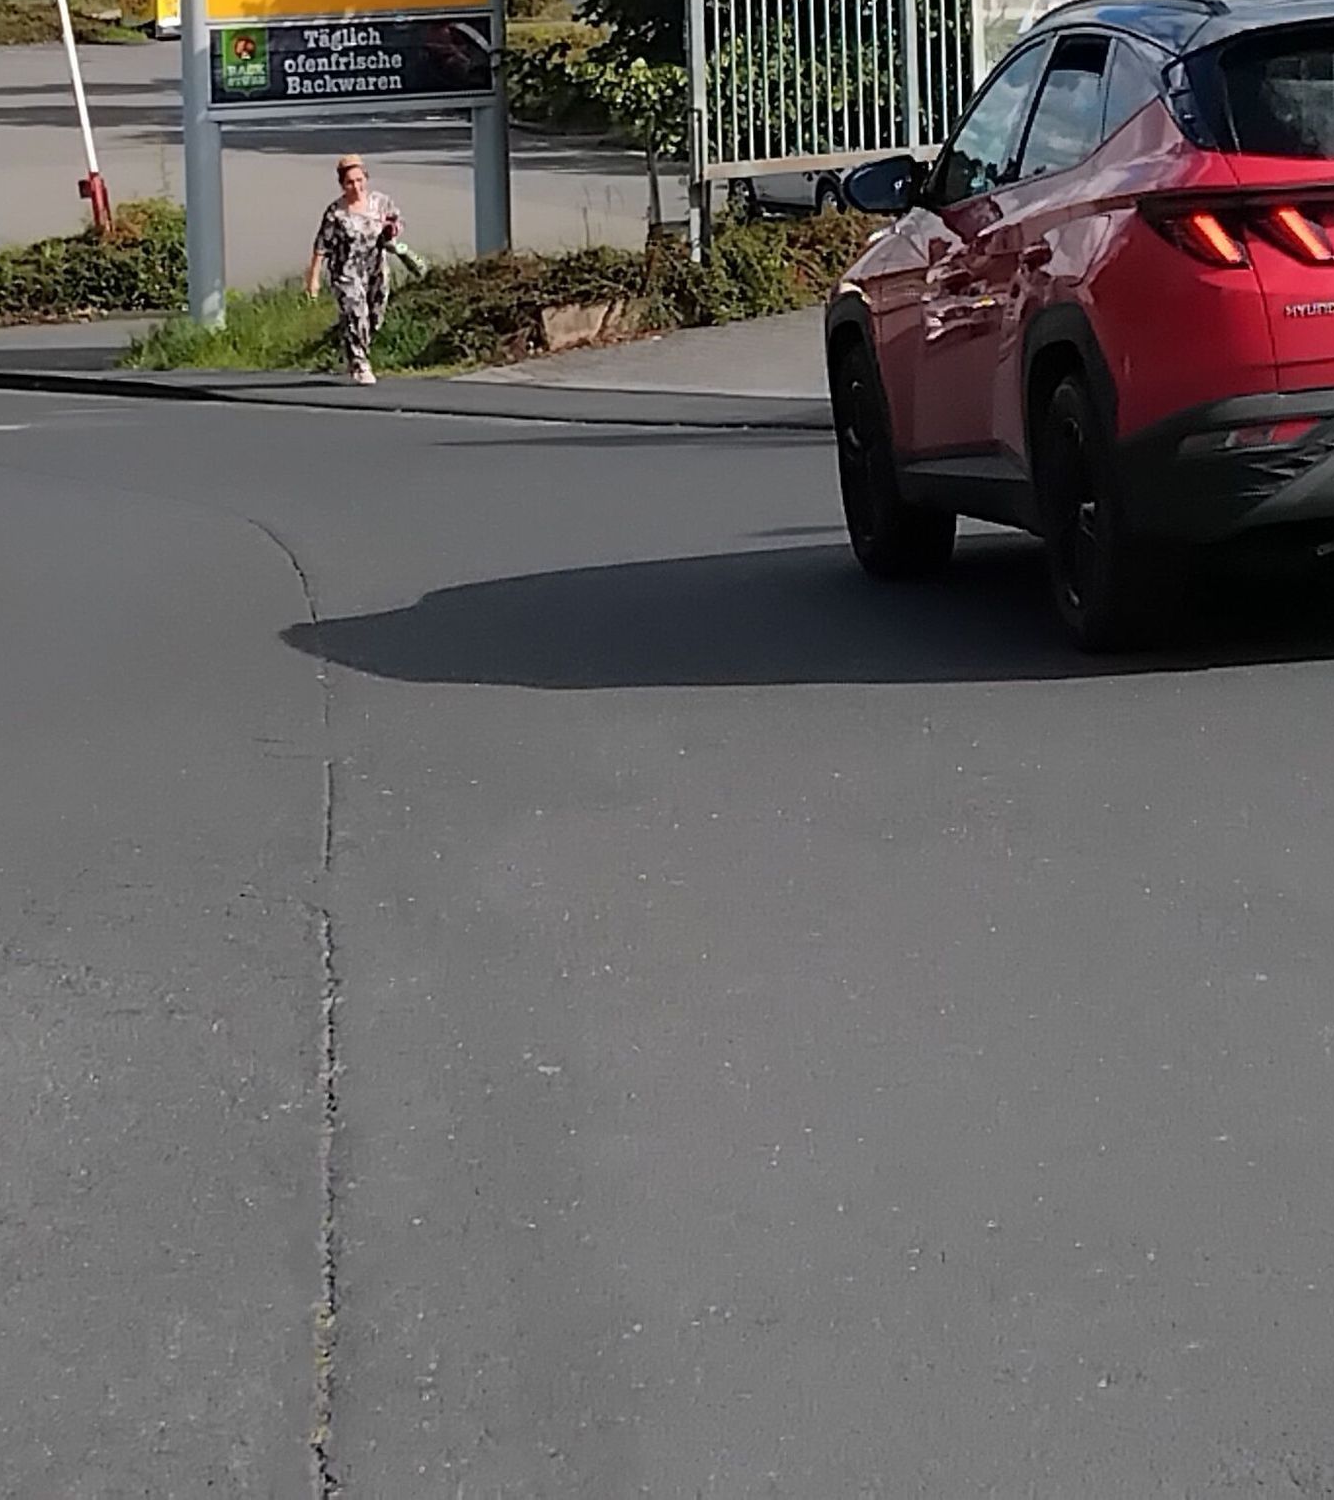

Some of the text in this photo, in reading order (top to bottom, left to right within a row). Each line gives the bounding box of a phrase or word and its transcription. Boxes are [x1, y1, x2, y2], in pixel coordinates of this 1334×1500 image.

[303, 27, 382, 51] Täglich
[283, 51, 403, 74] ofenfrische
[286, 75, 403, 95] Backwaren
